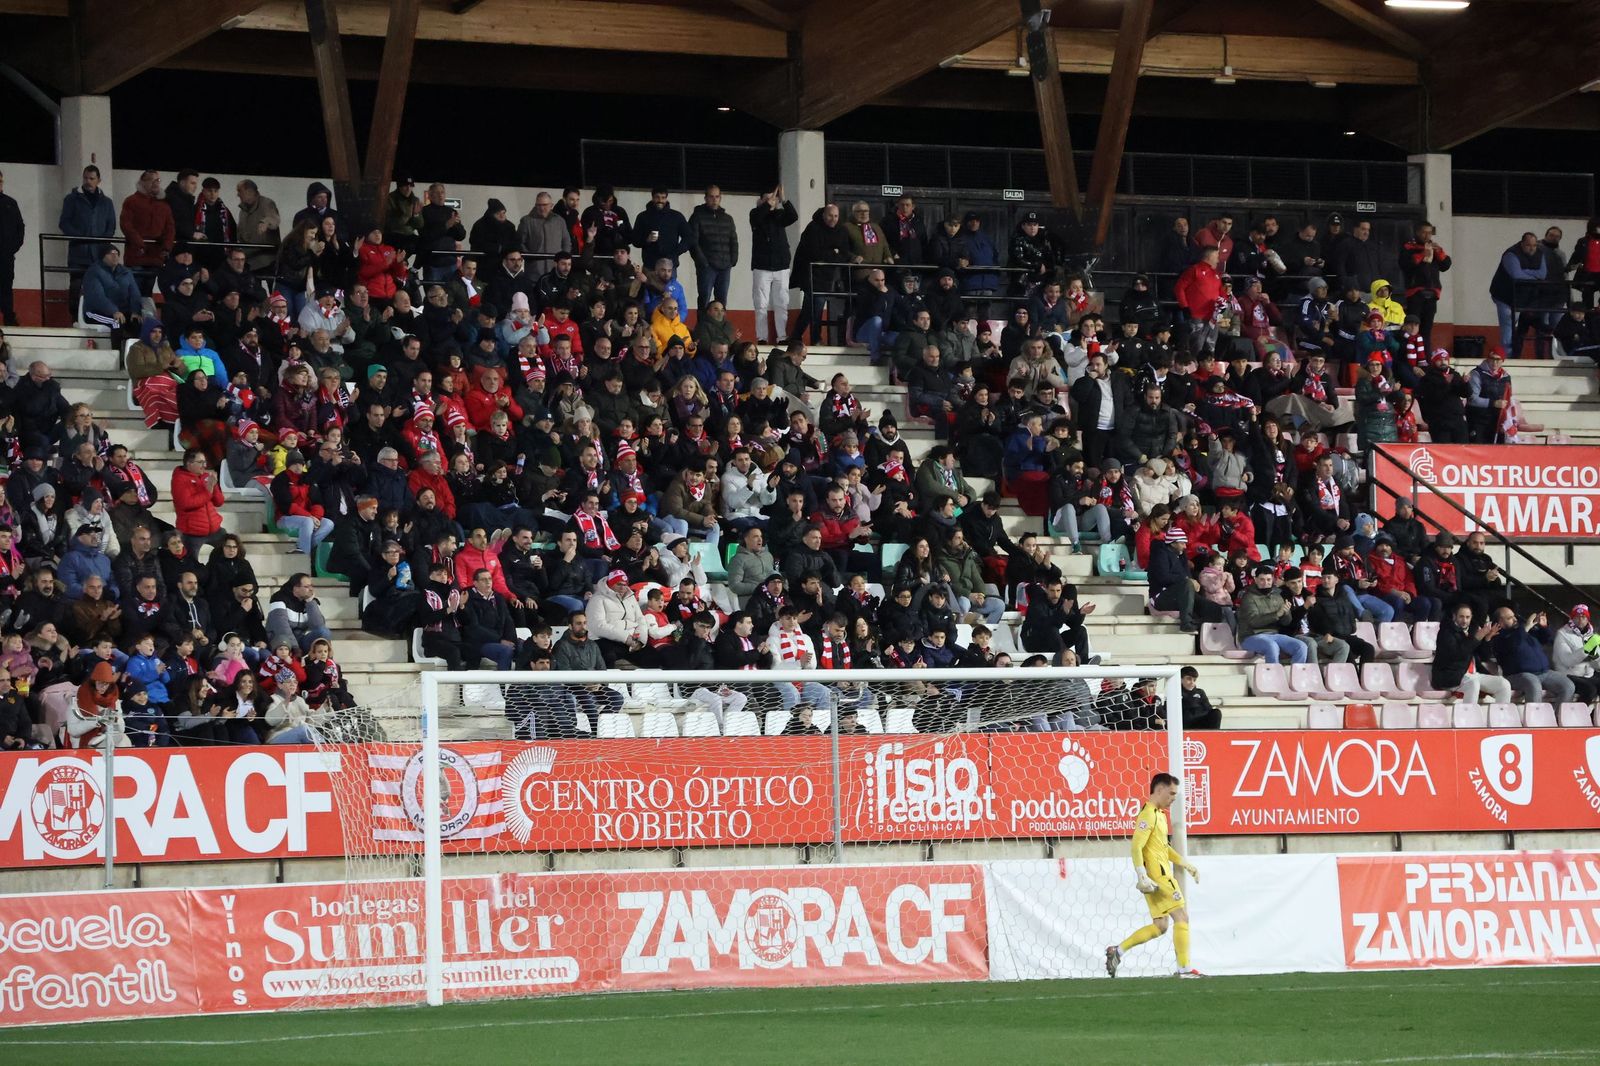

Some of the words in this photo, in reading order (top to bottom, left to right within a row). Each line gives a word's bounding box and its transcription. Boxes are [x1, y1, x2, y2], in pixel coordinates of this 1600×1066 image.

[884, 187, 901, 195] SALIDA
[1005, 191, 1023, 199] SALIDA
[1462, 487, 1600, 534] TAMAR
[525, 778, 673, 812] CENTRO
[684, 767, 814, 809] ÓPTICO
[875, 742, 978, 800] fisio
[1230, 738, 1437, 797] ZAMORA
[1498, 742, 1522, 793] 8
[1573, 765, 1600, 814] ZAMO
[225, 751, 342, 854] CF
[876, 785, 996, 831] readapt
[1011, 791, 1141, 832] podoactiva
[1230, 807, 1360, 826] AYUNTAMIENTO
[1468, 767, 1509, 824] ZAMORA
[593, 809, 752, 842] ROBERTO
[1078, 821, 1084, 830] Y
[1085, 819, 1137, 830] BIOMECÁNIC
[311, 894, 420, 919] bodegas
[500, 886, 537, 909] del
[264, 899, 565, 964] Sumller
[617, 886, 883, 974] ZAMORA
[885, 883, 972, 965] CF
[0, 958, 177, 1013] fantil
[268, 965, 570, 993] www.bodegasdsumiller.com
